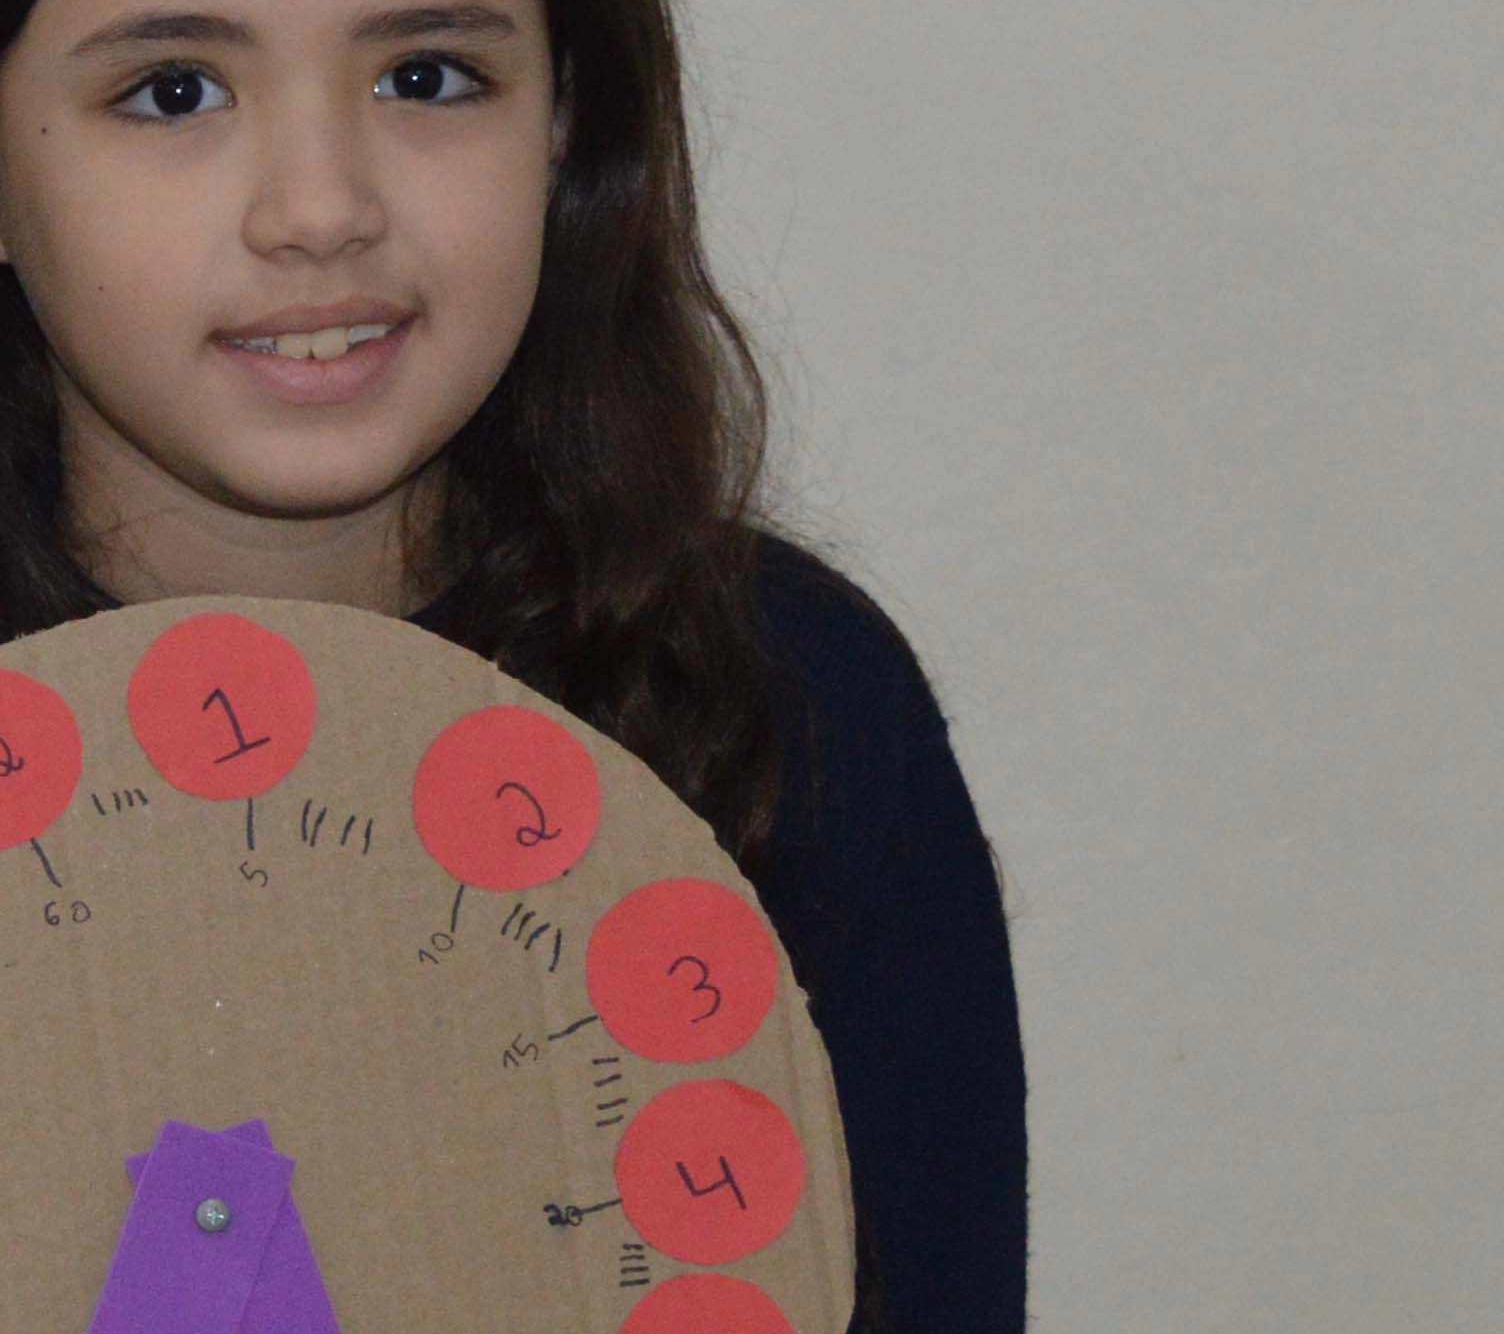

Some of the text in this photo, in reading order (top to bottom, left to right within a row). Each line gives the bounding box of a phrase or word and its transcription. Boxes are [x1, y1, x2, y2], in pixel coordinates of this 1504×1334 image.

[202, 687, 271, 764] 1
[495, 781, 561, 848] 2
[238, 860, 269, 888] 5
[43, 900, 92, 927] 60
[415, 930, 455, 966] 10
[667, 954, 722, 1023] 3
[501, 1032, 541, 1070] 15
[676, 1156, 747, 1210] 4
